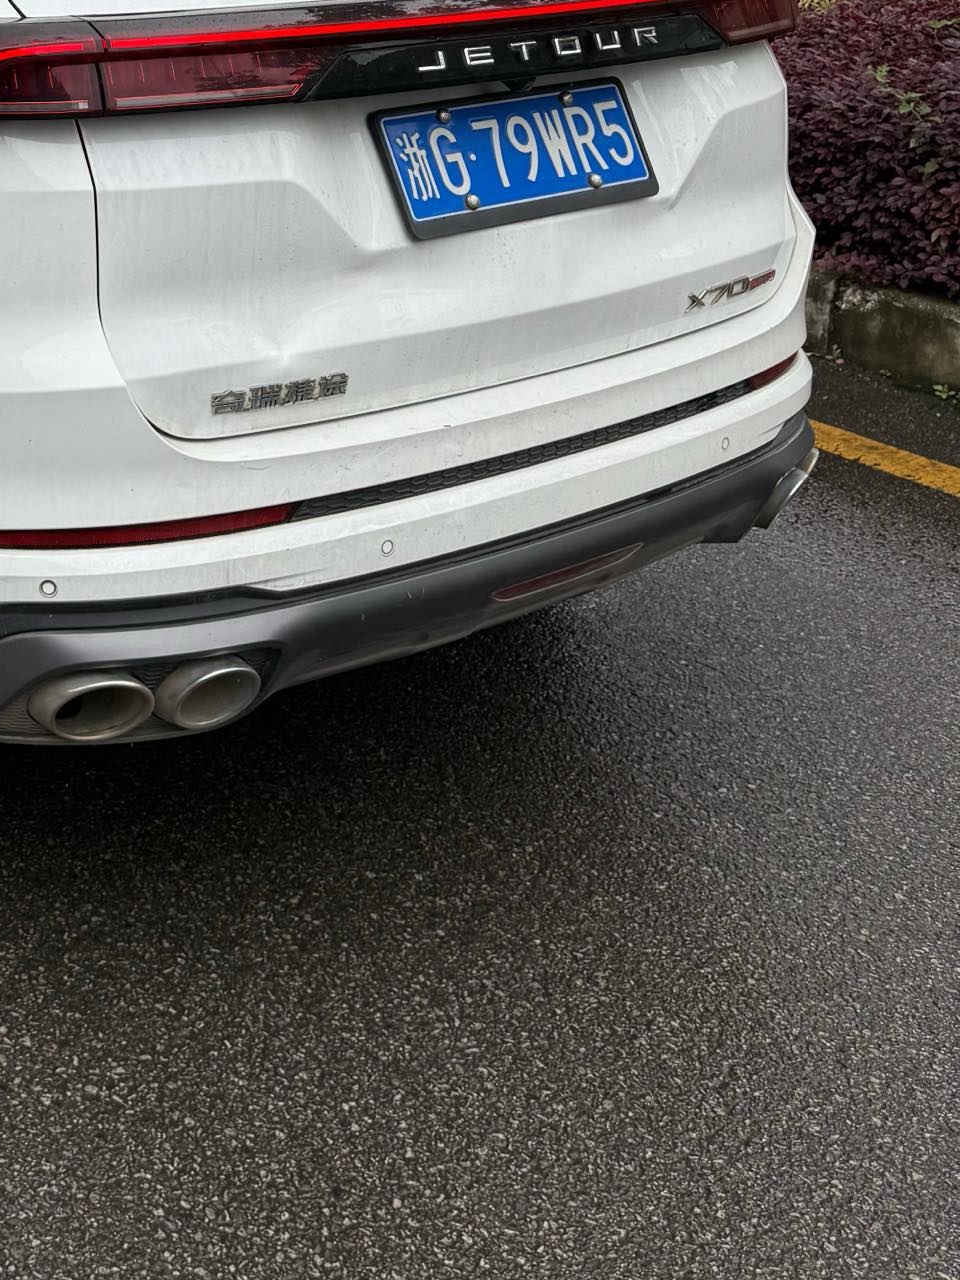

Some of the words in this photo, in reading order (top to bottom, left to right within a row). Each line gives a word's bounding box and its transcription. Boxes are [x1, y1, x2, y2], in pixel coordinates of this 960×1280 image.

[418, 26, 660, 71] JETOUR
[211, 372, 349, 416] 奇瑞捷途
